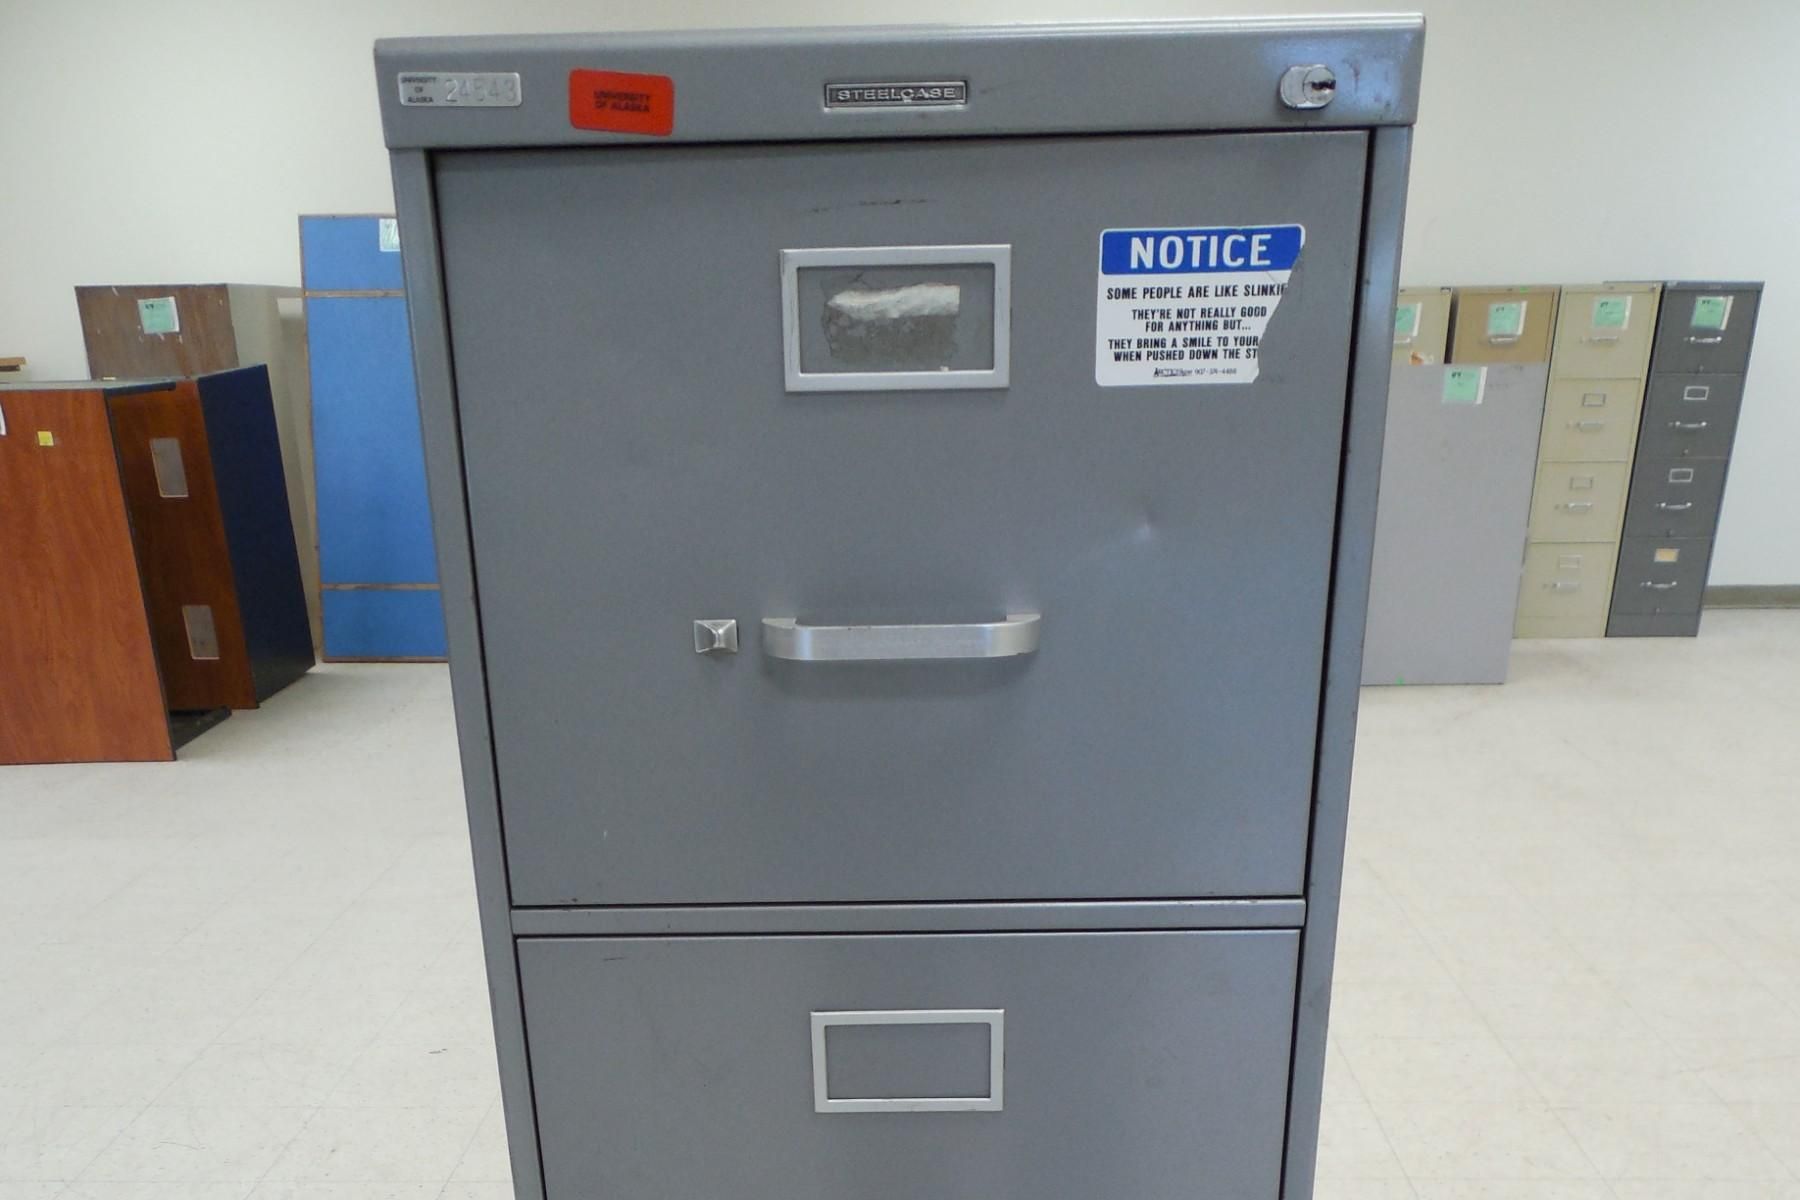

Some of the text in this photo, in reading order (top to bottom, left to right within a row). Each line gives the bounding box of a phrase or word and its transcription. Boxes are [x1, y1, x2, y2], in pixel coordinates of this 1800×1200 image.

[837, 87, 956, 100] STEELCASE
[1130, 234, 1272, 270] NOTICE
[1107, 287, 1138, 300] SOME
[1143, 286, 1183, 299] PEOPLE
[1188, 285, 1209, 298] ARE
[1215, 284, 1239, 297] LIKE
[1132, 306, 1268, 320] THEY'RE NOT REALLY GOOD
[1145, 319, 1252, 333] FOR ANYTHING BUT...
[1108, 336, 1259, 350] THEY BRING A SMILE TO YOUR
[1114, 351, 1142, 362] WHEN
[1146, 350, 1185, 361] PUSHED
[1189, 349, 1218, 360] DOWN
[1223, 349, 1241, 360] THE
